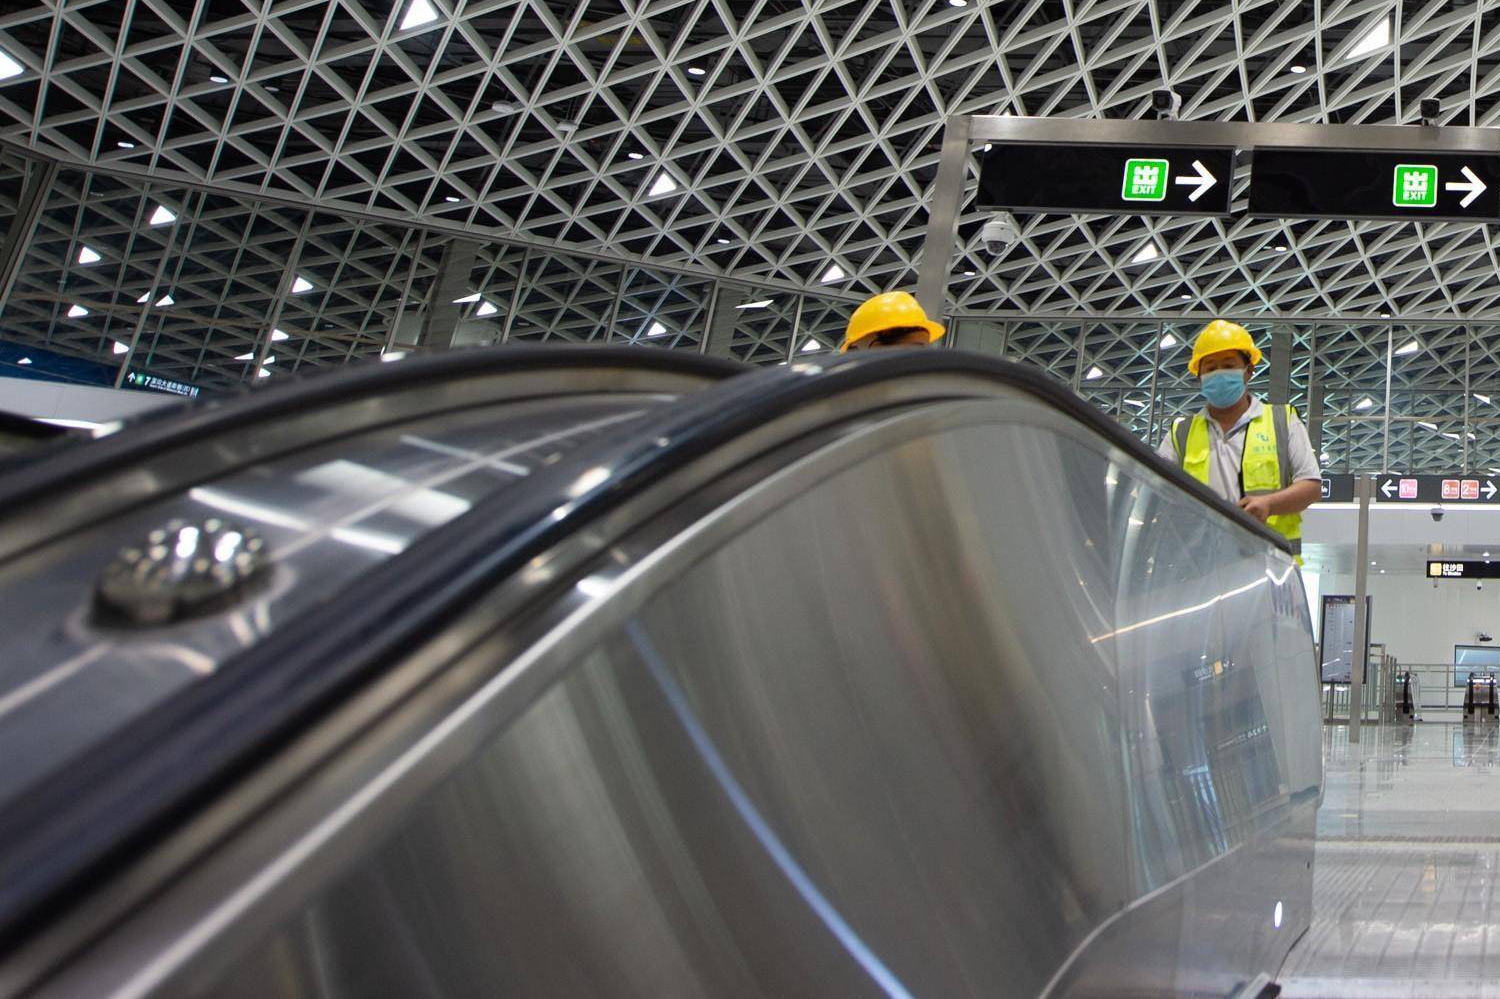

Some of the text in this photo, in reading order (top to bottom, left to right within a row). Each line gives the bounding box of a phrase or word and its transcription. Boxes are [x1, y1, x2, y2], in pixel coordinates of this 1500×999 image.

[1131, 185, 1157, 195] EXIT
[1402, 191, 1427, 201] EXIT
[144, 376, 152, 386] 7
